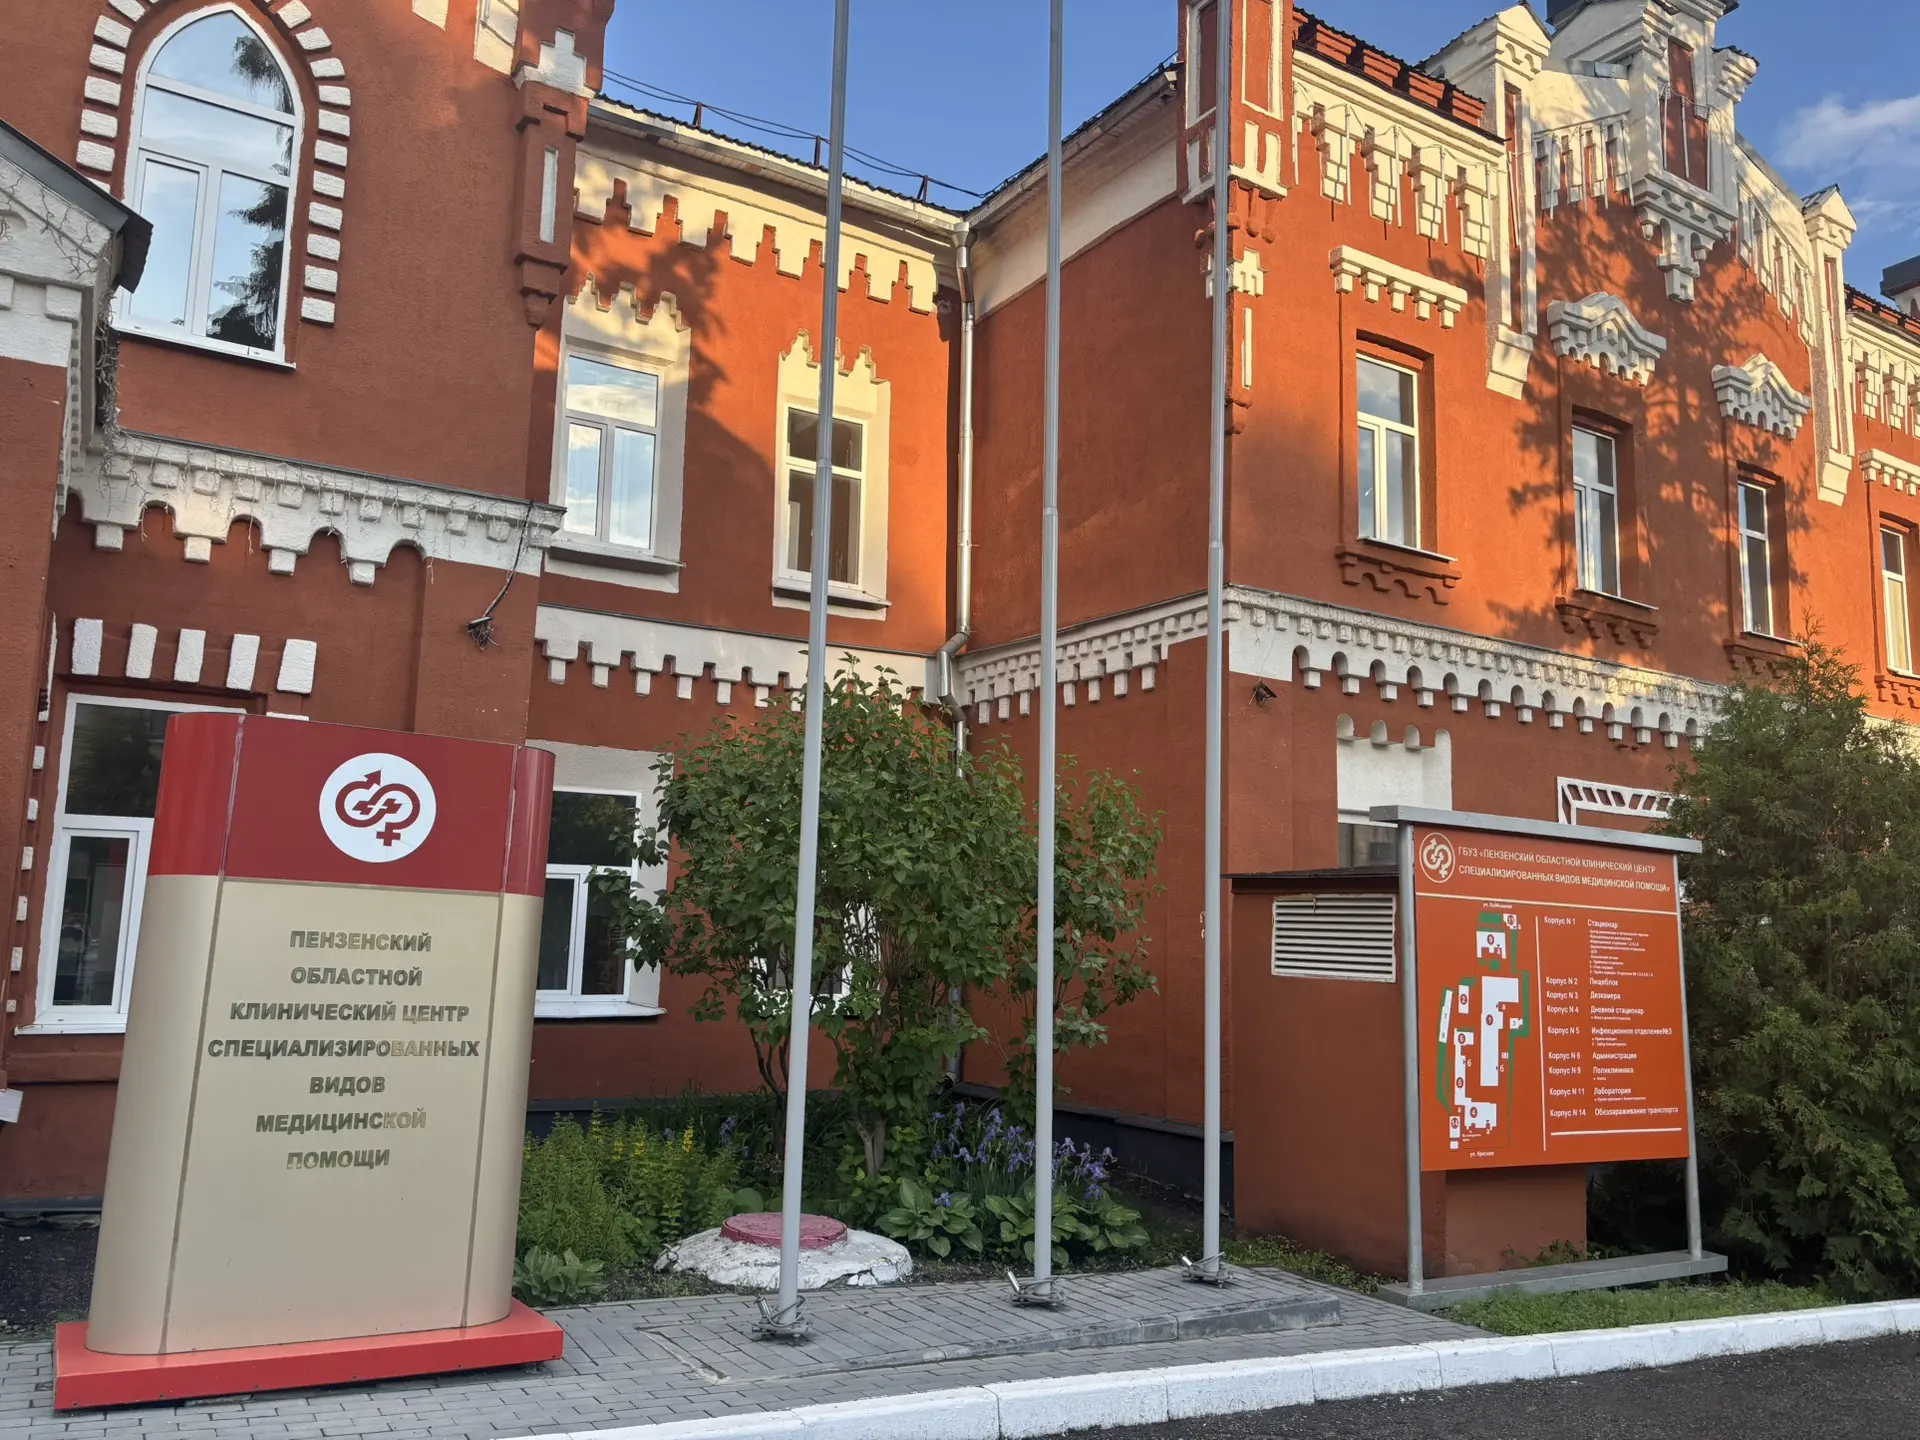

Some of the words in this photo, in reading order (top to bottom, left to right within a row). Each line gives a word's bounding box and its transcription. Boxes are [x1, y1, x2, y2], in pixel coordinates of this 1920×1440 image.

[1458, 846, 1478, 857] ГБУЗ
[1479, 848, 1534, 862] «ПЕНЗЕНСКИЙ
[1536, 854, 1580, 866] ОБЛАСТНОЙ
[1582, 858, 1632, 872] КЛИНИЧЕСКИЙ
[1634, 864, 1656, 874] ЦЕНТР
[1458, 865, 1554, 882] СПЕЦИАЛИЗИРОВАННЫХ
[1555, 873, 1580, 884] ВИДОВ
[1582, 876, 1634, 889] МЕДИЦИНСКОЙ
[1636, 881, 1670, 892] ПОМОЩИ»
[1544, 916, 1565, 926] Корпус
[1588, 919, 1618, 929] Стационар
[290, 930, 432, 952] ПЕНЗЕНСКИЙ
[290, 966, 422, 986] ОБЛАСТНОЙ
[1546, 977, 1567, 986] Корпус
[1590, 978, 1618, 986] Пищеблок
[1547, 991, 1567, 1000] Корпус
[1590, 991, 1620, 1000] Дезкамера
[230, 1001, 396, 1021] КЛИНИЧЕСКИЙ
[402, 1004, 469, 1024] ЦЕНТР
[1547, 1005, 1568, 1014] Корпус
[1591, 1006, 1614, 1014] Дневной
[1616, 1008, 1644, 1016] стационар
[1548, 1026, 1568, 1036] Корпус
[1592, 1027, 1633, 1035] Инфекционное
[208, 1039, 480, 1059] СПЕЦИАЛИЗИРОВАННЫХ
[1549, 1052, 1569, 1061] Корпус
[1593, 1052, 1637, 1060] Администрация
[1549, 1067, 1570, 1075] Корпус
[309, 1076, 385, 1097] ВИДОВ
[1594, 1087, 1631, 1095] Лаборатория
[1550, 1088, 1570, 1097] Корпус
[1550, 1109, 1571, 1118] Корпус
[1595, 1108, 1646, 1116] Обеззараживание
[1647, 1107, 1678, 1115] транспорта
[256, 1108, 426, 1135] МЕДИЦИНСКОЙ
[287, 1149, 390, 1169] ПОМОЩИ
